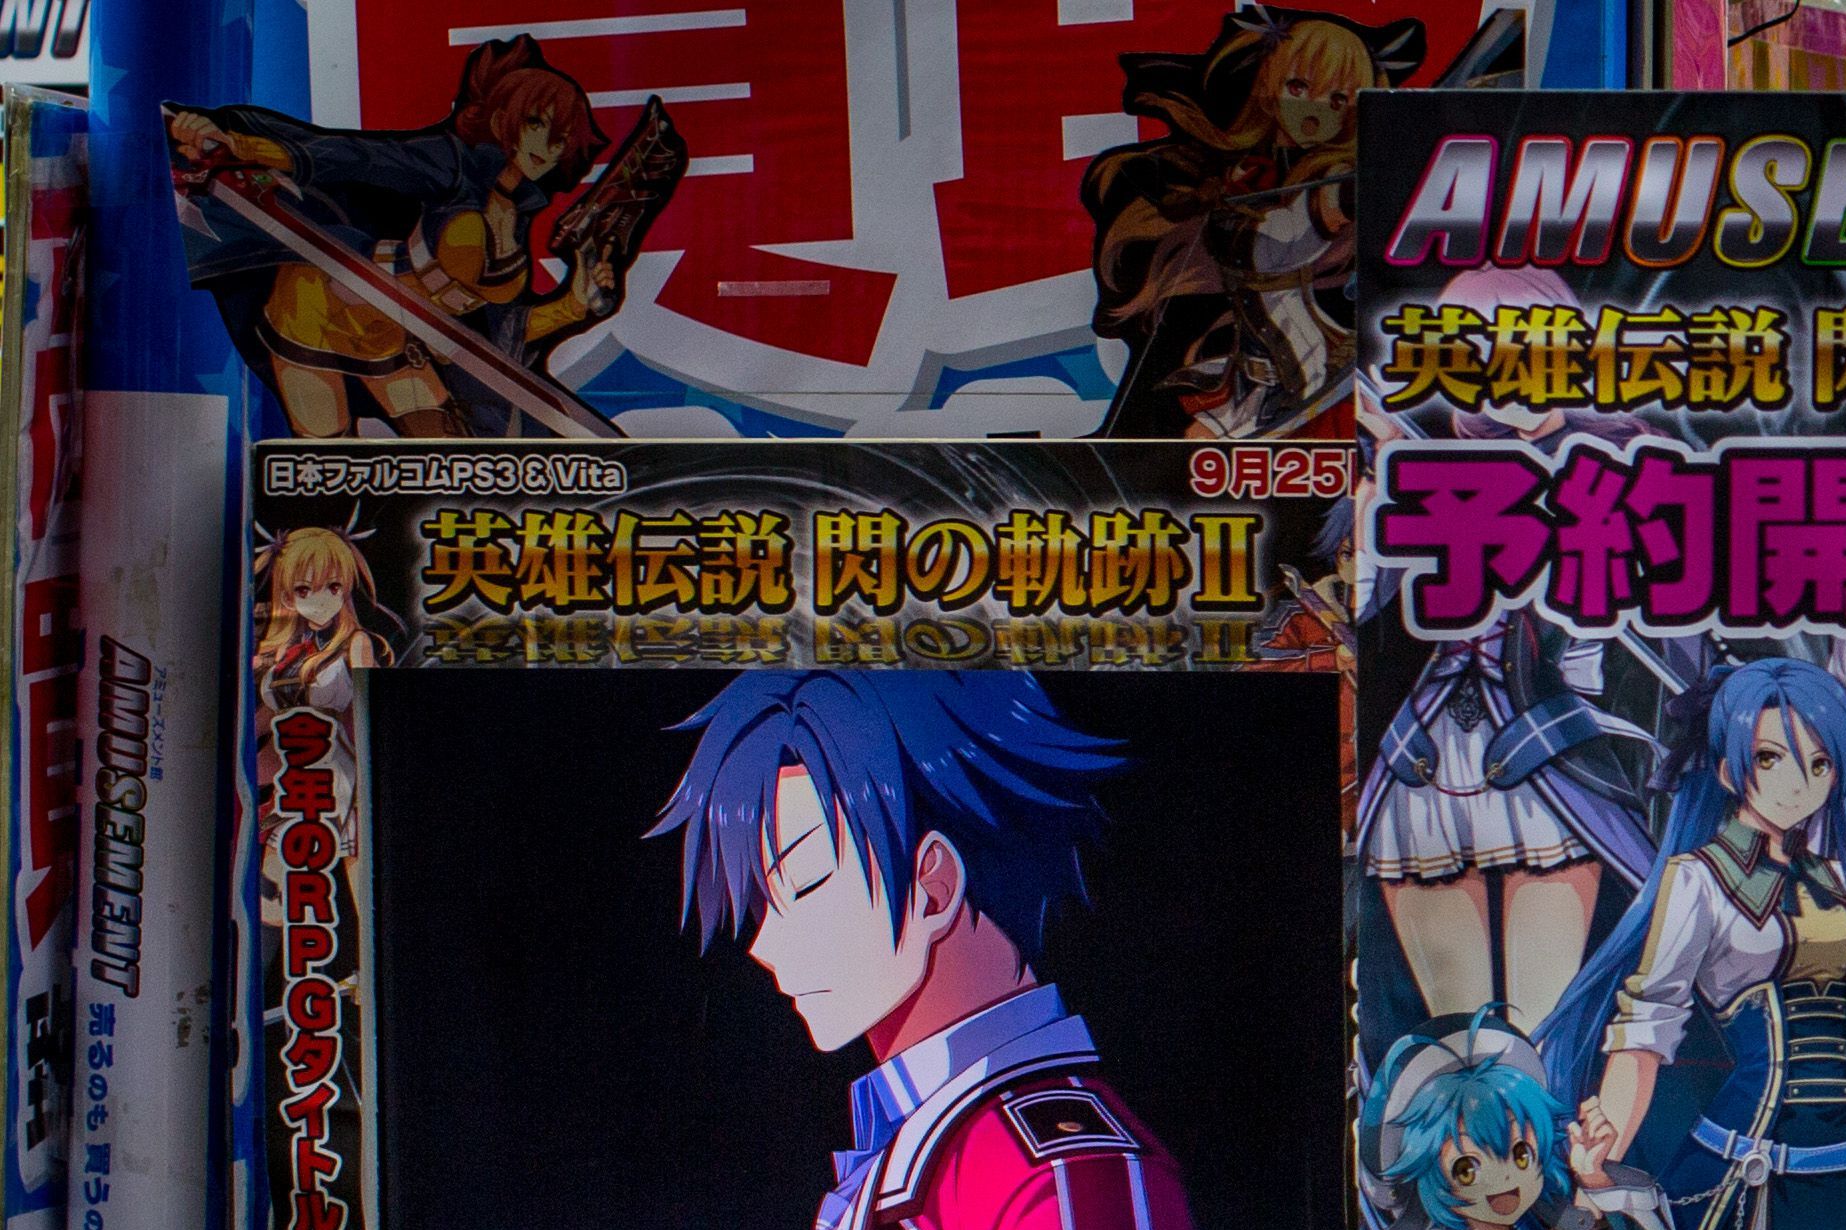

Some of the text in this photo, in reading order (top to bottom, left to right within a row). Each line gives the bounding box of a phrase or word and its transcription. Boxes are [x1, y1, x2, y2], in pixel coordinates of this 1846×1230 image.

[1382, 303, 1792, 412] 英雄伝説
[556, 458, 626, 493] Vita
[1189, 449, 1356, 498] 9月25
[423, 508, 794, 617] 英雄伝説
[91, 634, 152, 998] AMUSEMENT
